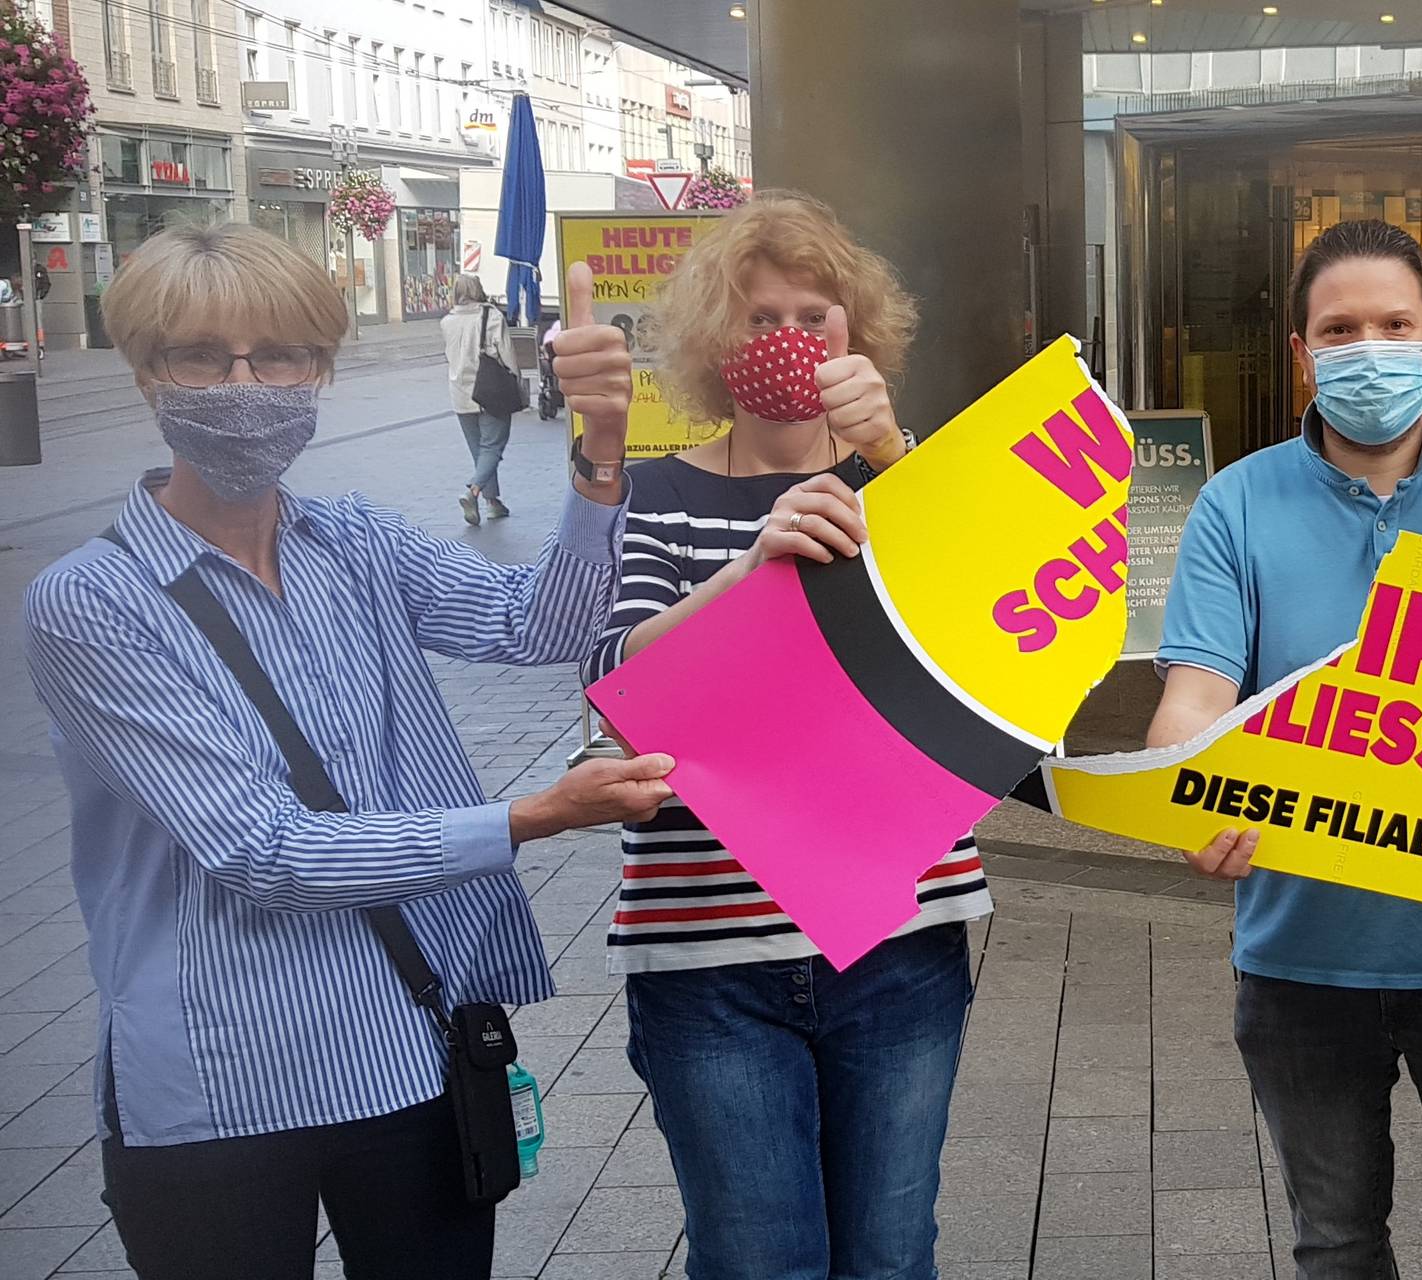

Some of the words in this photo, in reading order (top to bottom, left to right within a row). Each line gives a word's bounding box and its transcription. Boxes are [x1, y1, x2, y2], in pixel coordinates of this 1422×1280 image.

[470, 108, 493, 123] dm
[294, 167, 343, 189] ESPRI
[602, 227, 692, 248] HEUTE
[586, 254, 683, 276] BILLIG
[627, 444, 651, 452] BZUG
[652, 444, 680, 452] ALLER
[1009, 385, 1132, 509] W
[1134, 438, 1201, 467] ÜSS.
[1128, 496, 1159, 504] UPONS
[1161, 495, 1181, 503] VON
[1131, 485, 1161, 494] PTIEREN
[1163, 484, 1179, 492] WIR
[1128, 505, 1160, 514] ARSTADT
[1144, 525, 1182, 534] UMTAUS
[992, 503, 1127, 653] SCH
[1171, 767, 1300, 828] DIESE
